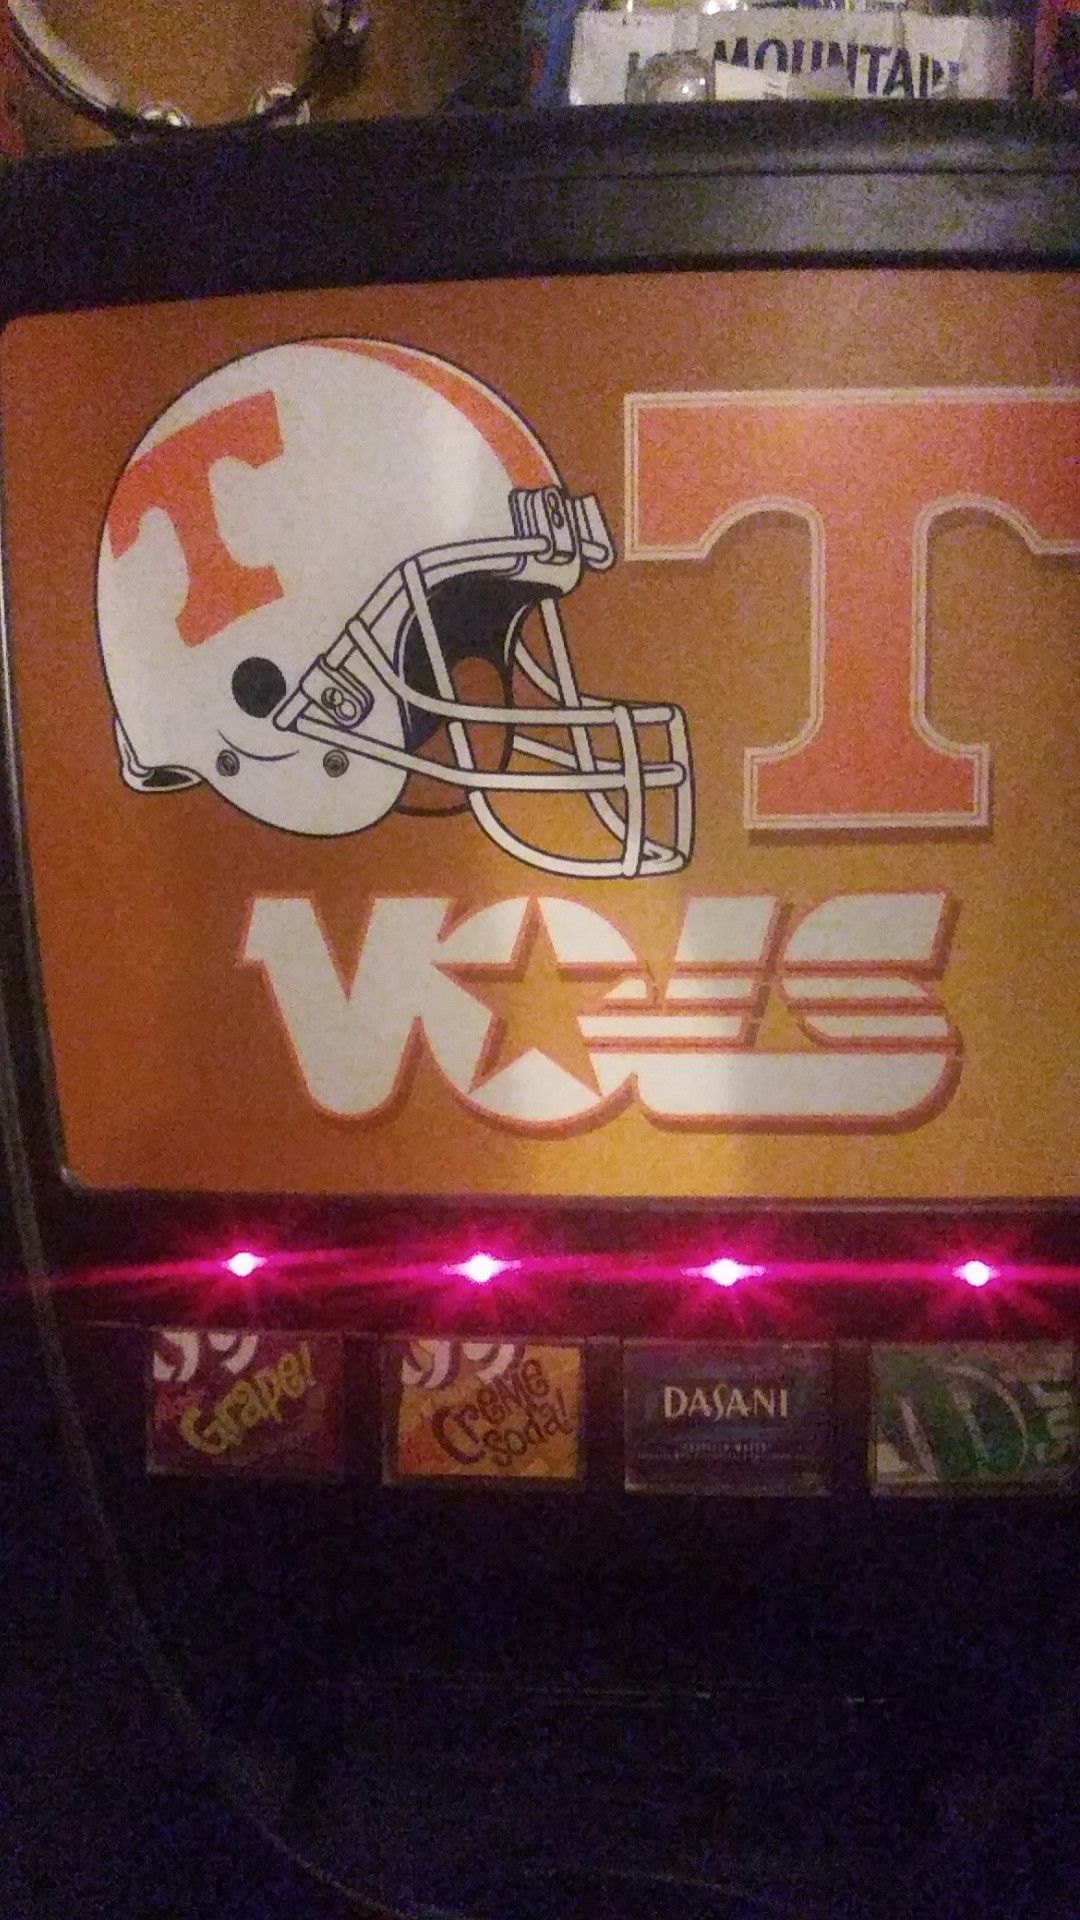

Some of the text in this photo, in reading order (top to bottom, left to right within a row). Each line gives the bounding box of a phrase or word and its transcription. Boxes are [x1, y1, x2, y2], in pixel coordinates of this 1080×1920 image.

[107, 390, 284, 649] T
[623, 386, 1080, 831] T
[662, 1383, 788, 1422] DASANI
